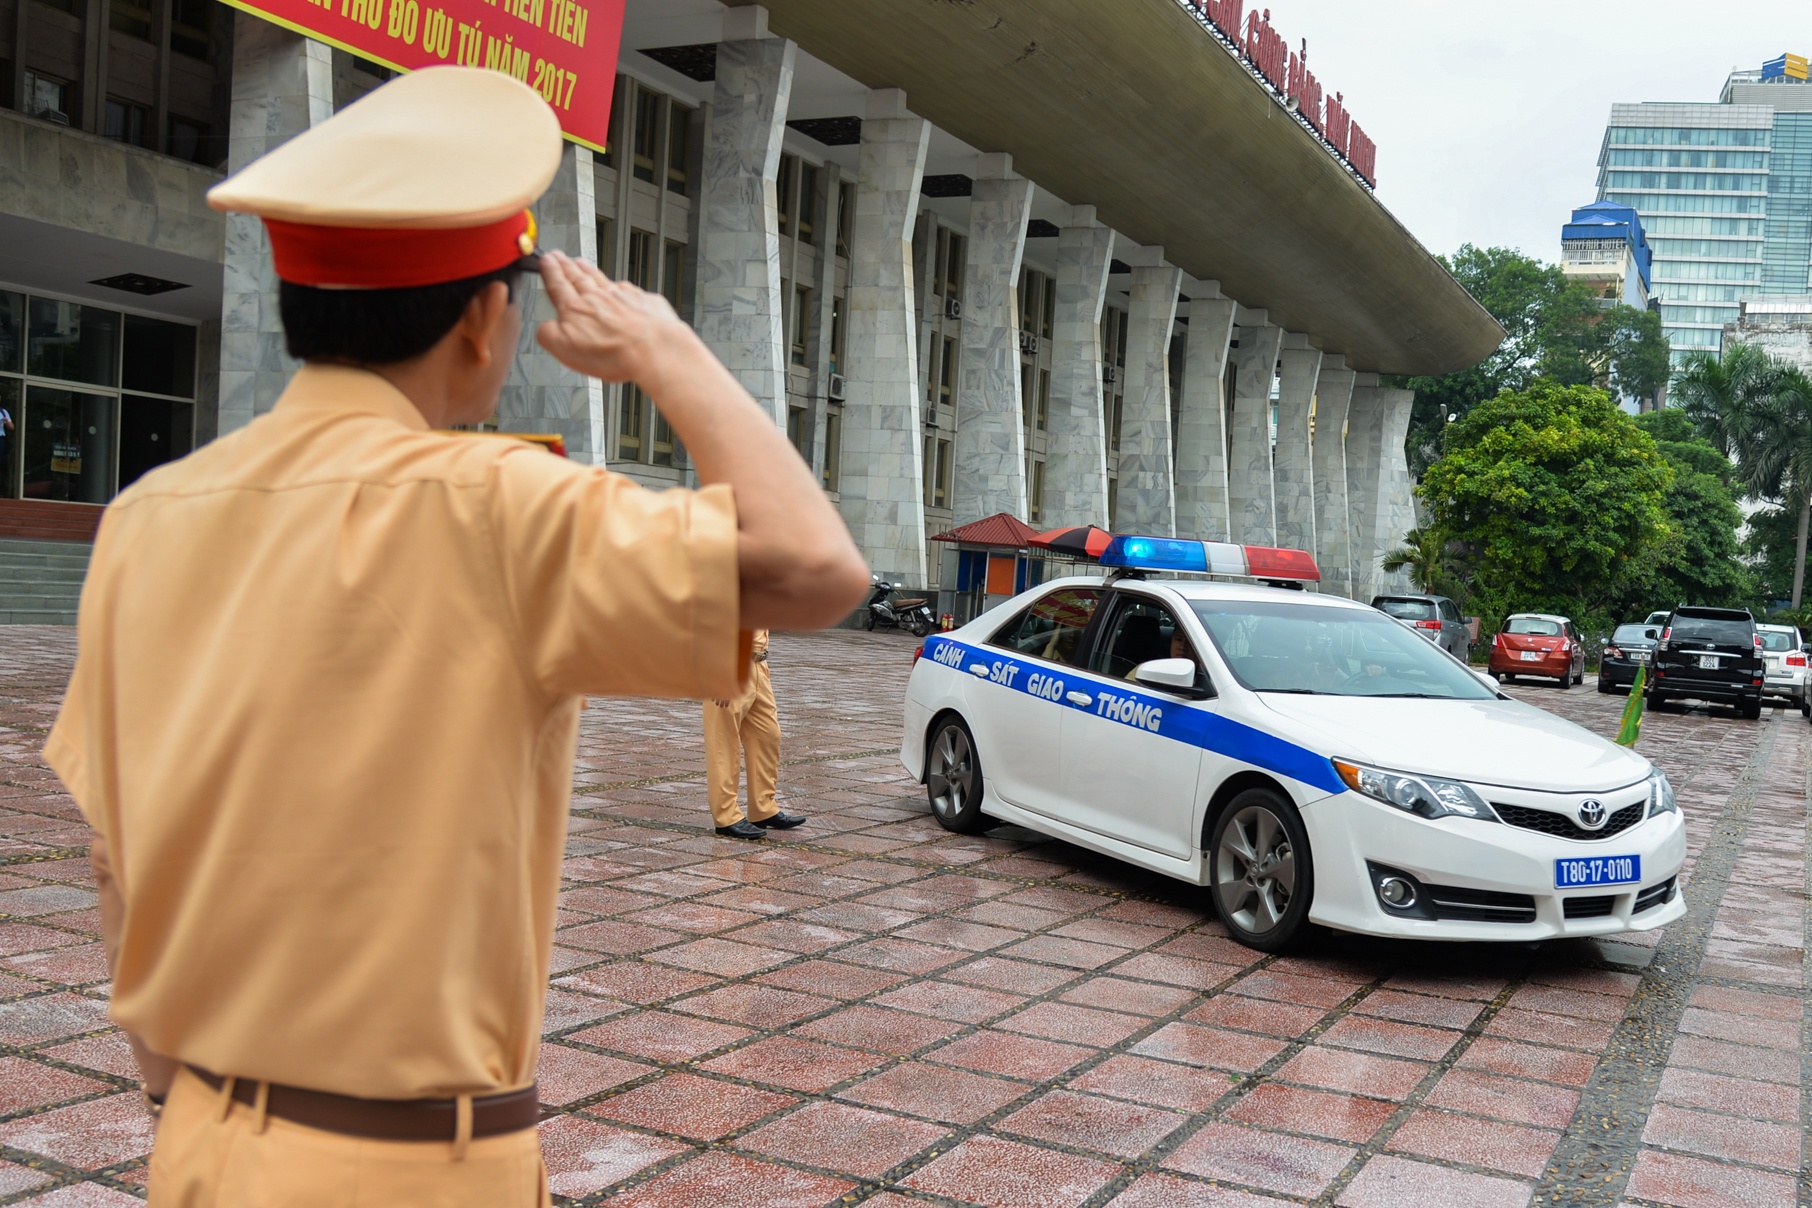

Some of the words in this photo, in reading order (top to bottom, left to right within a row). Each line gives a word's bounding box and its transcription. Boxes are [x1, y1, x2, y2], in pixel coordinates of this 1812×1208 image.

[533, 58, 578, 111] 2017
[1563, 239, 1599, 250] MAYFAIR
[1601, 239, 1625, 250] HOTEL
[989, 660, 1020, 687] SÁT
[1027, 672, 1064, 702] GIAO
[1096, 691, 1163, 732] THÔNG
